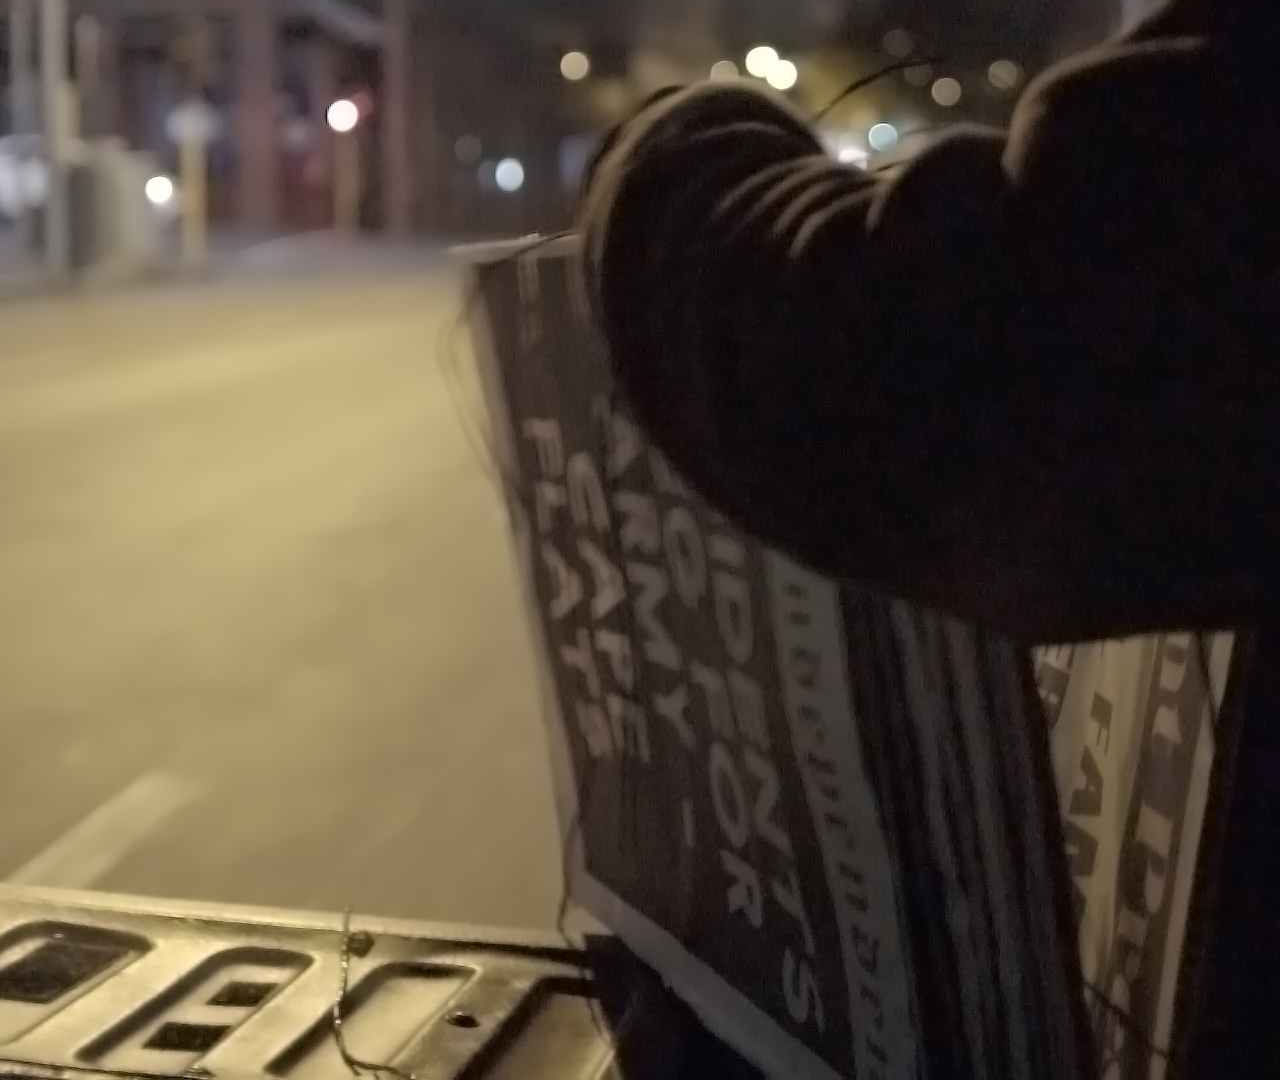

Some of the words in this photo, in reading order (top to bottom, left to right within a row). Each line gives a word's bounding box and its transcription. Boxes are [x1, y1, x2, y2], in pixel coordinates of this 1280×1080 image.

[522, 418, 622, 762] FLATS
[566, 451, 650, 762] CAPE
[592, 397, 697, 752] ARMY
[690, 662, 764, 928] FOR
[705, 528, 827, 1034] IDENTS
